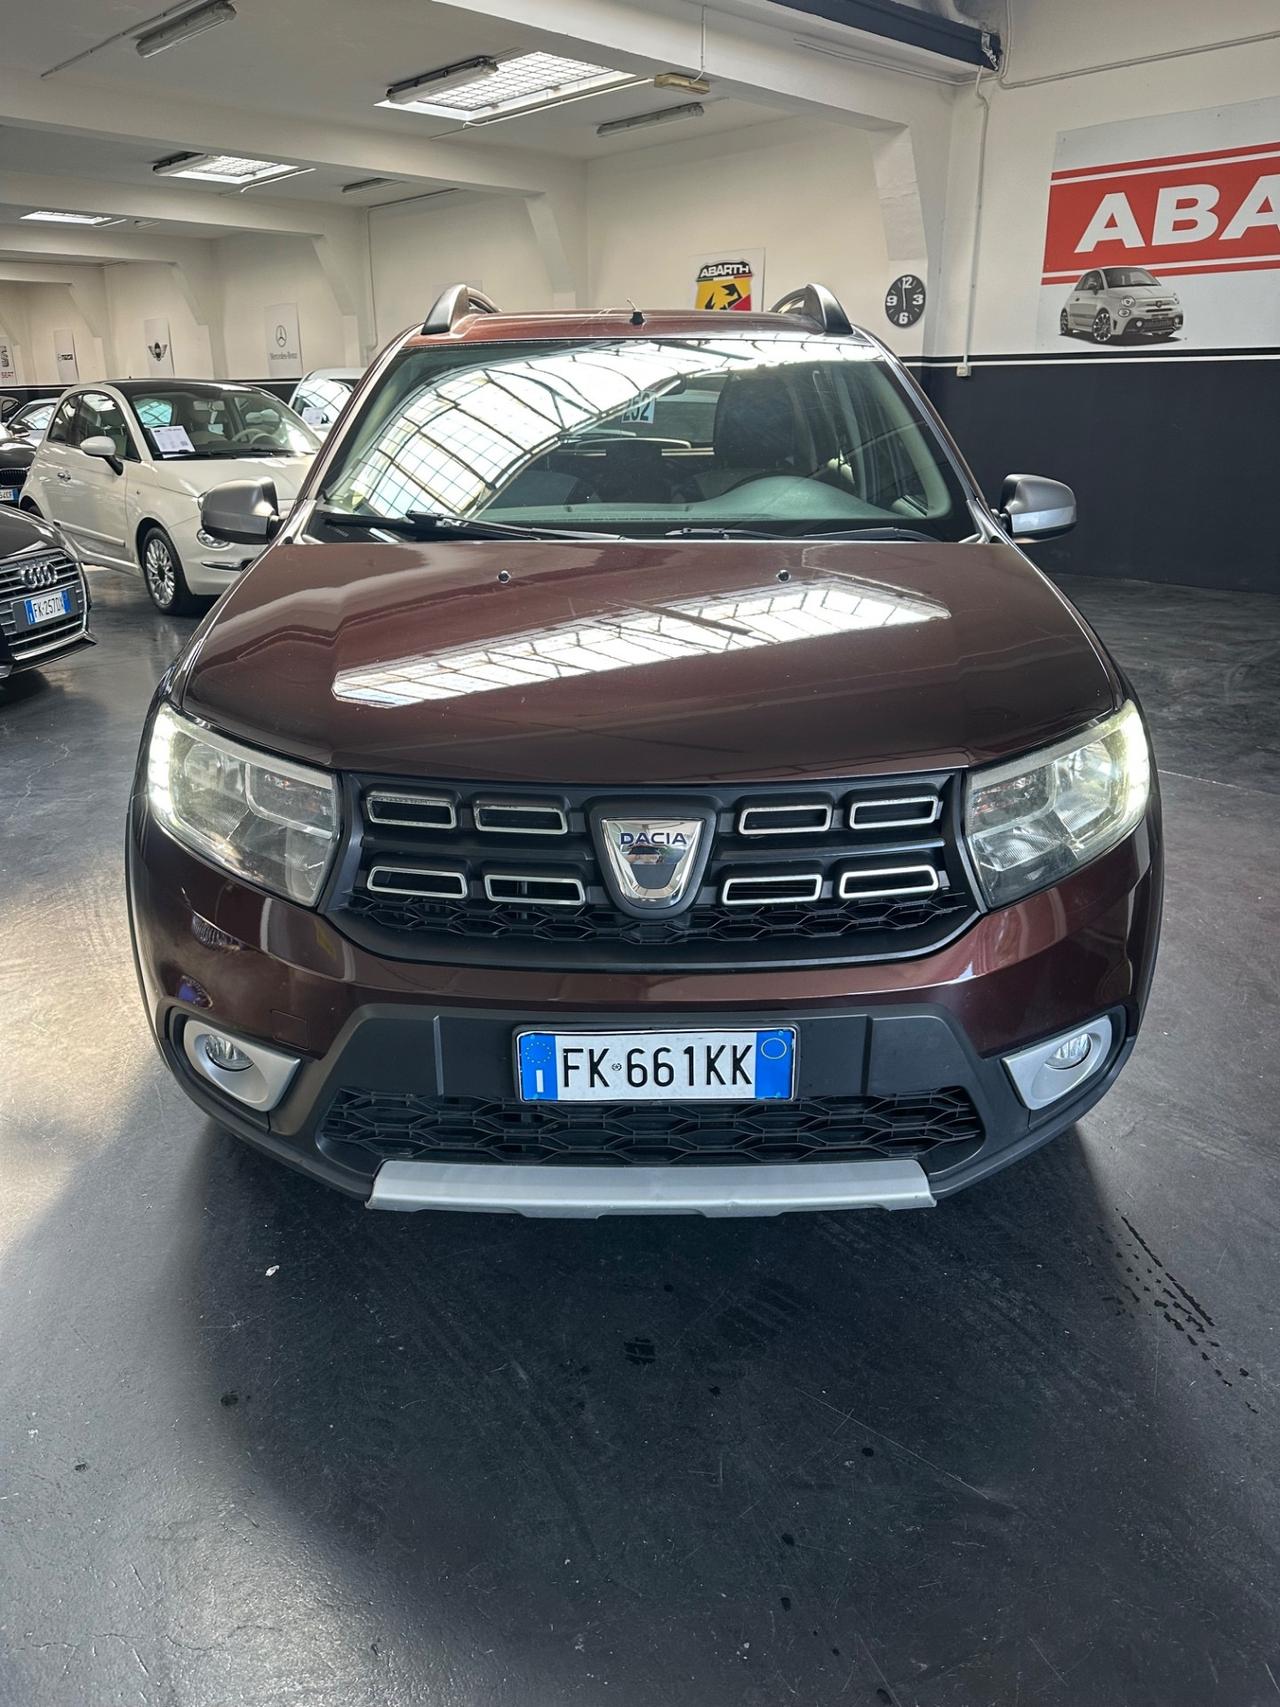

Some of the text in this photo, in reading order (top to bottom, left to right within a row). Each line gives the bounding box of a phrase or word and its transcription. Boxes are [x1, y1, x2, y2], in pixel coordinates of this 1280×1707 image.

[1074, 174, 1280, 253] ABA
[700, 264, 749, 278] ABARTH
[902, 276, 913, 289] 12
[886, 295, 898, 306] 9
[912, 294, 924, 305] 3
[899, 312, 909, 324] 6
[620, 832, 687, 845] DACIA
